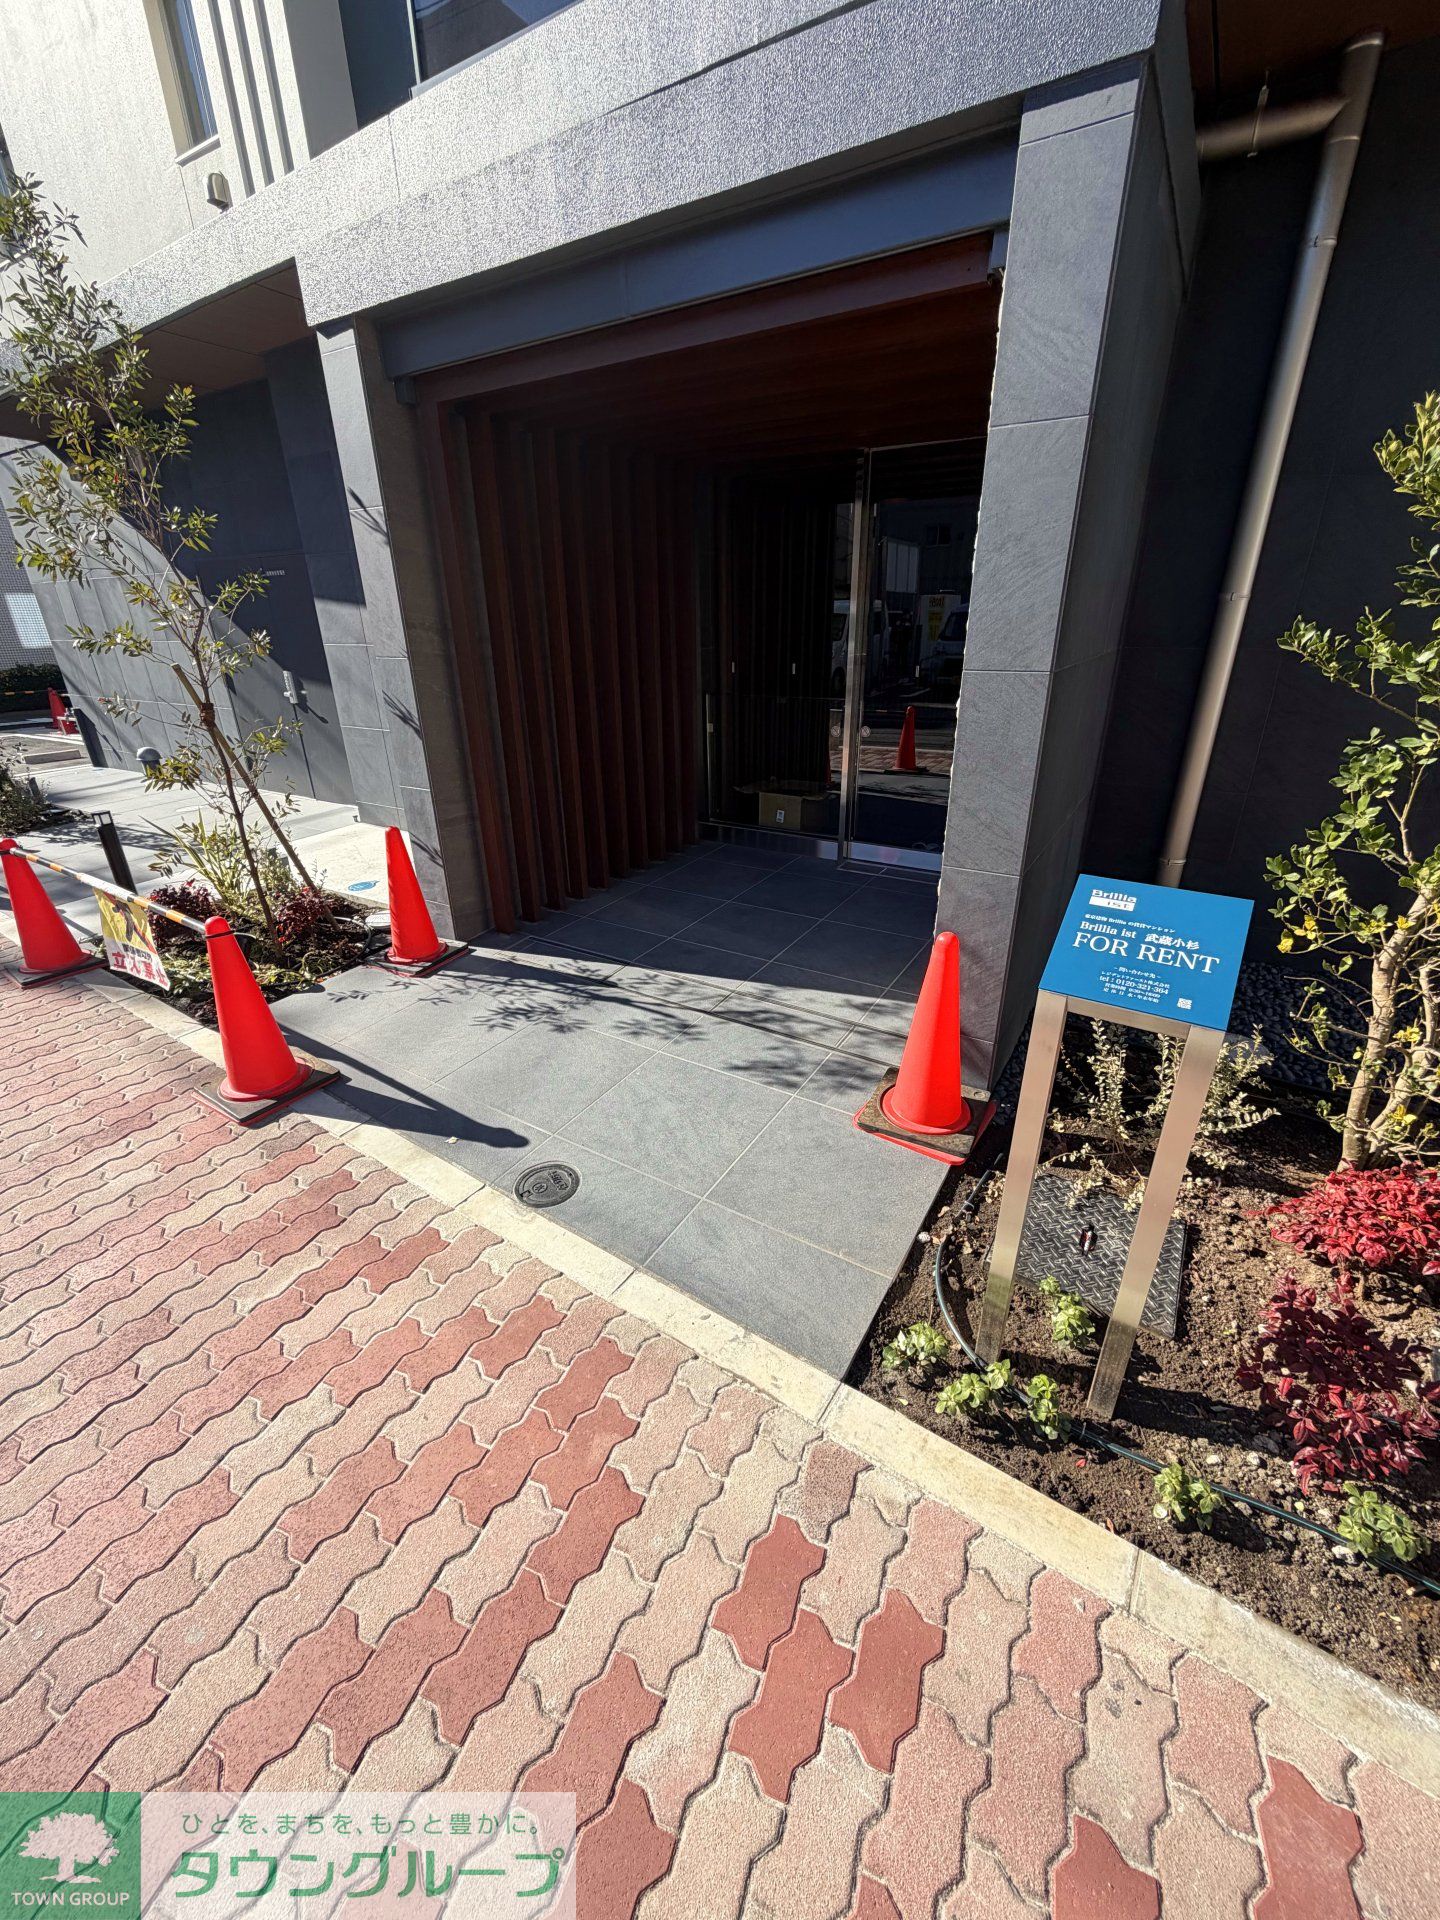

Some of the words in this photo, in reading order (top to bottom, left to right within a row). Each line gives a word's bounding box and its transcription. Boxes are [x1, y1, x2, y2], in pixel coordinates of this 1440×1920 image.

[1092, 889, 1137, 903] Brillia
[1080, 921, 1118, 935] Brillia
[1121, 928, 1137, 939] ist
[1144, 933, 1200, 950] 武蔵小杉
[1072, 931, 1129, 957] FOR
[1136, 943, 1220, 974] RENT
[112, 951, 169, 988] 立入禁止
